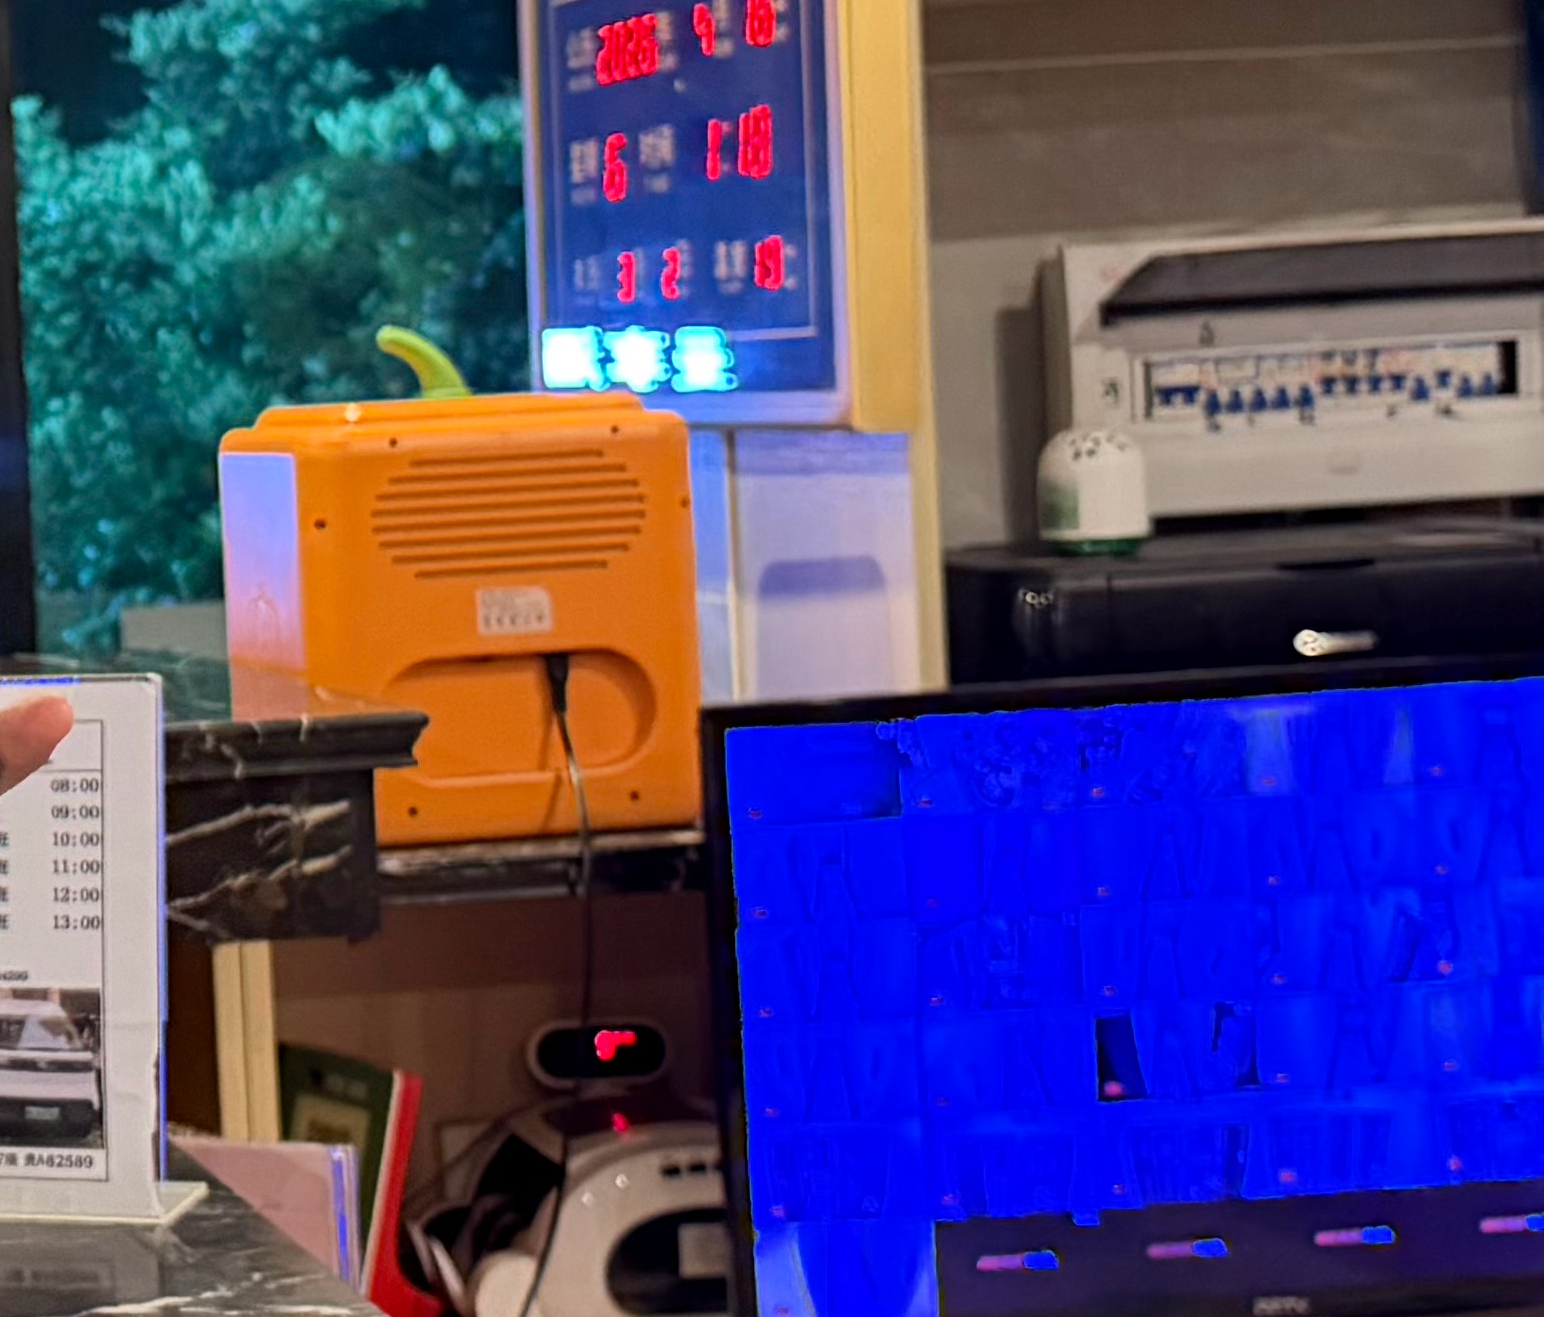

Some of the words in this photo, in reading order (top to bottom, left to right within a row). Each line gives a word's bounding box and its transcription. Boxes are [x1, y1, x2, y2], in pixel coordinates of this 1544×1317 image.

[50, 778, 100, 793] 08:00
[50, 805, 100, 819] 09:00
[52, 832, 100, 847] 10:00
[52, 859, 100, 874] 11:00
[52, 887, 100, 902] 12:00
[52, 914, 100, 929] 13:00
